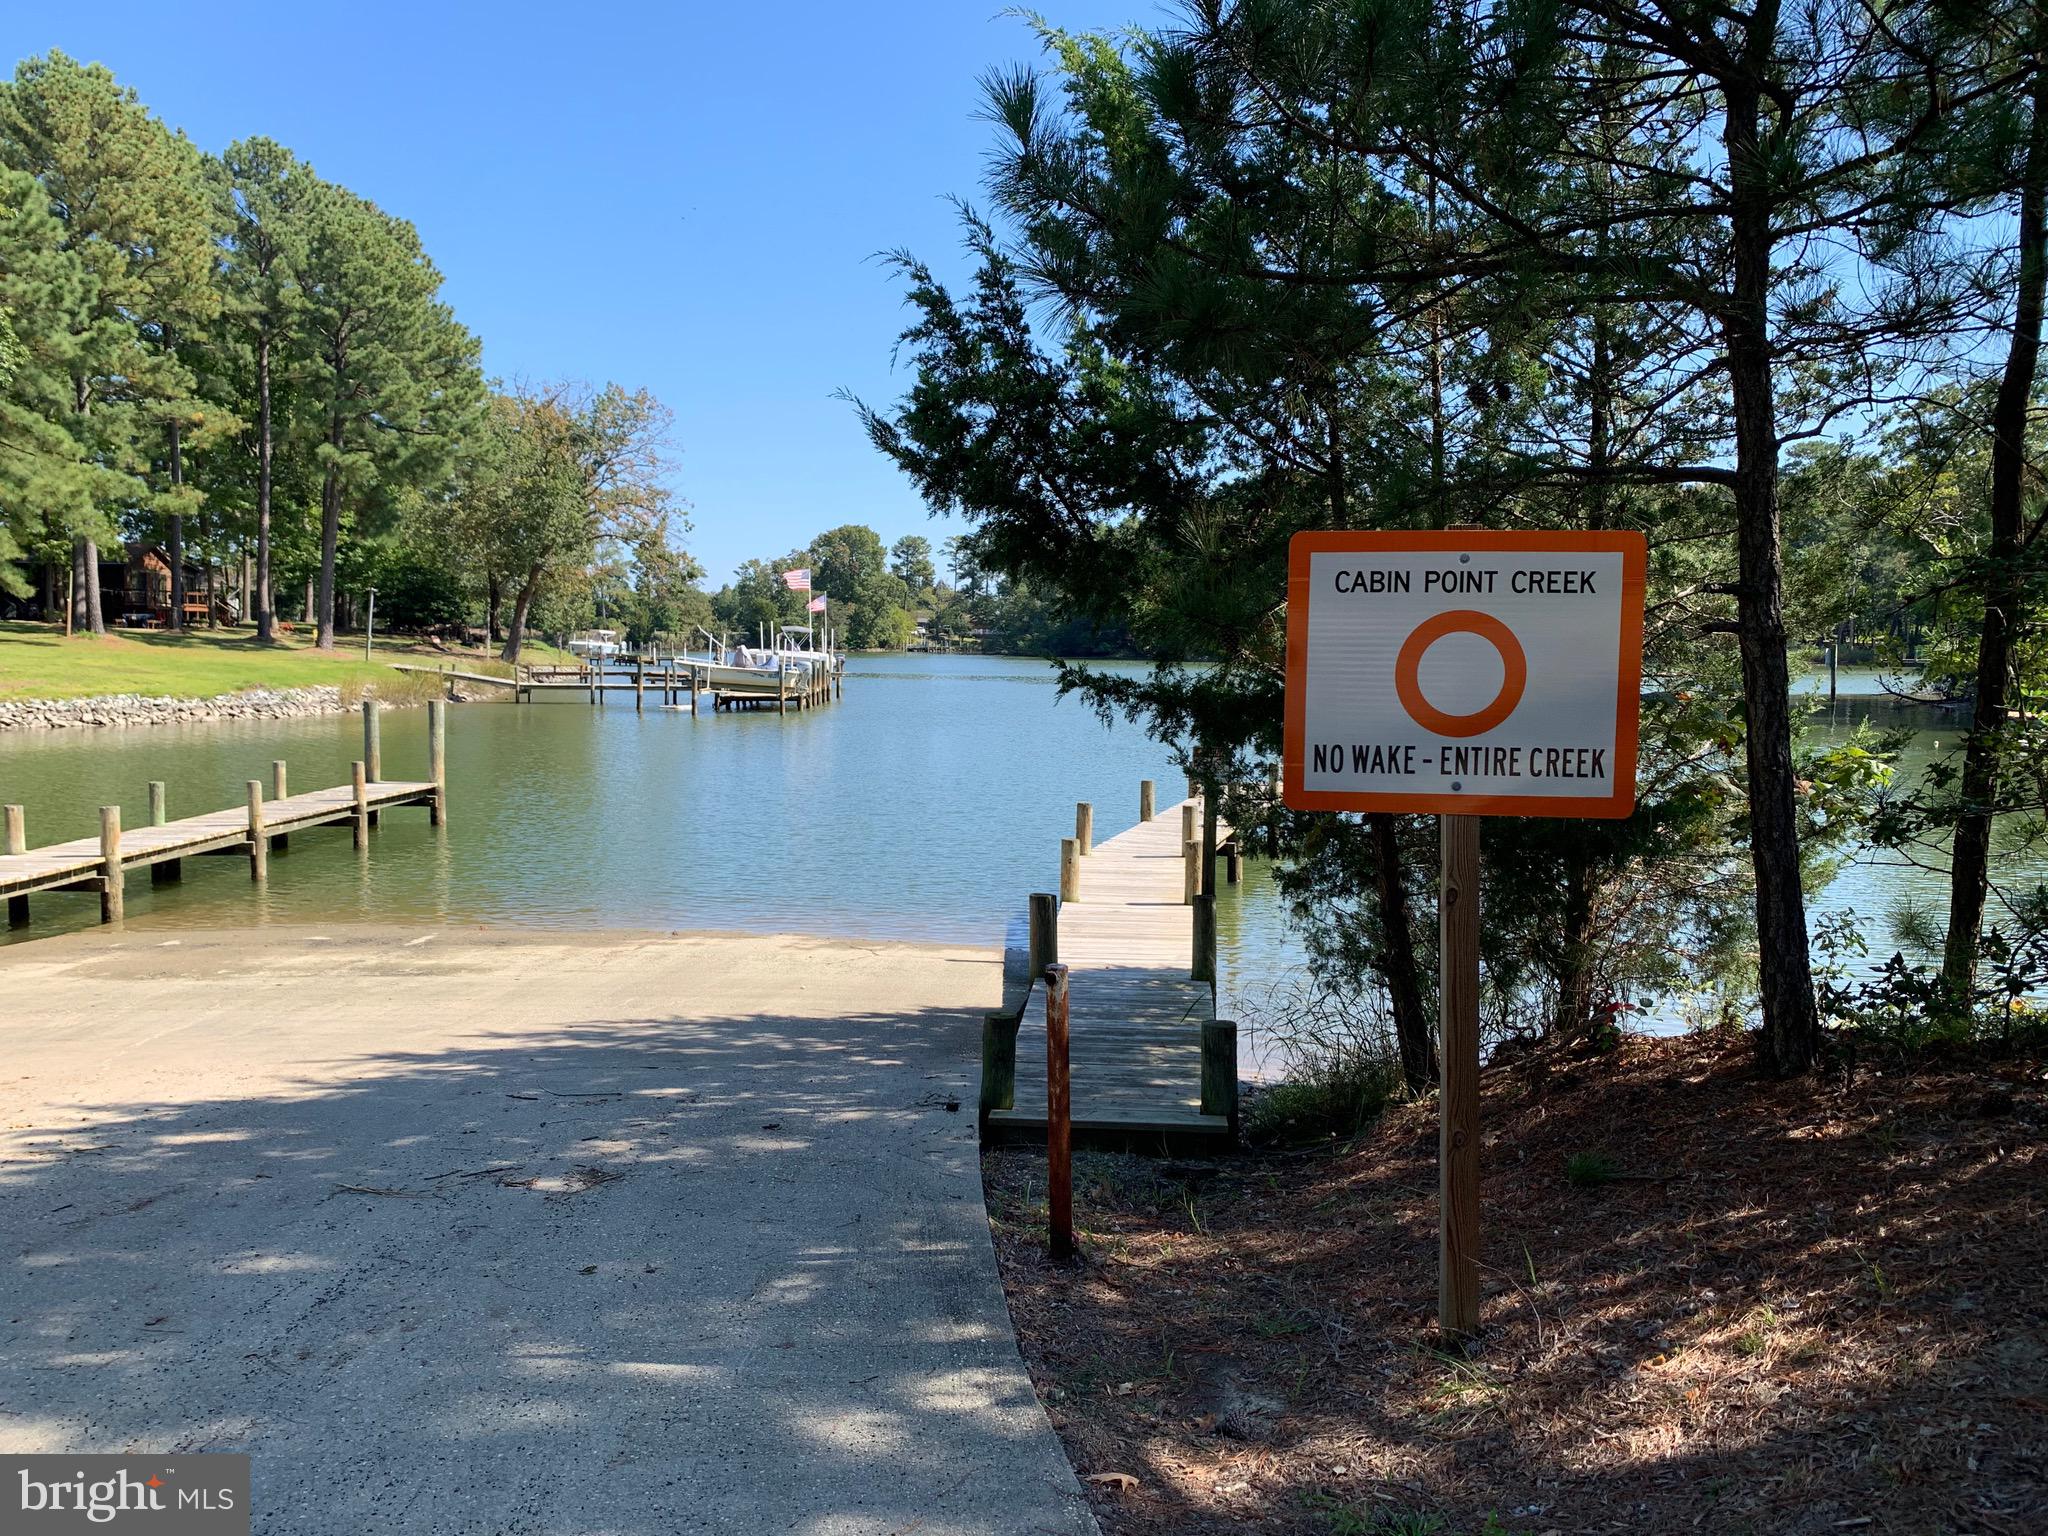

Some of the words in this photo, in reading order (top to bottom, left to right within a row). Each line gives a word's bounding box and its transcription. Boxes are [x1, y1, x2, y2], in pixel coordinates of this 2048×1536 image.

[1335, 570, 1410, 593] CABIN
[1424, 571, 1498, 593] POINT
[1511, 571, 1597, 594] CREEK
[1314, 744, 1344, 773] NO
[1352, 745, 1416, 774] WAKE
[1440, 746, 1521, 776] ENTIRE
[1529, 748, 1605, 778] CREEK
